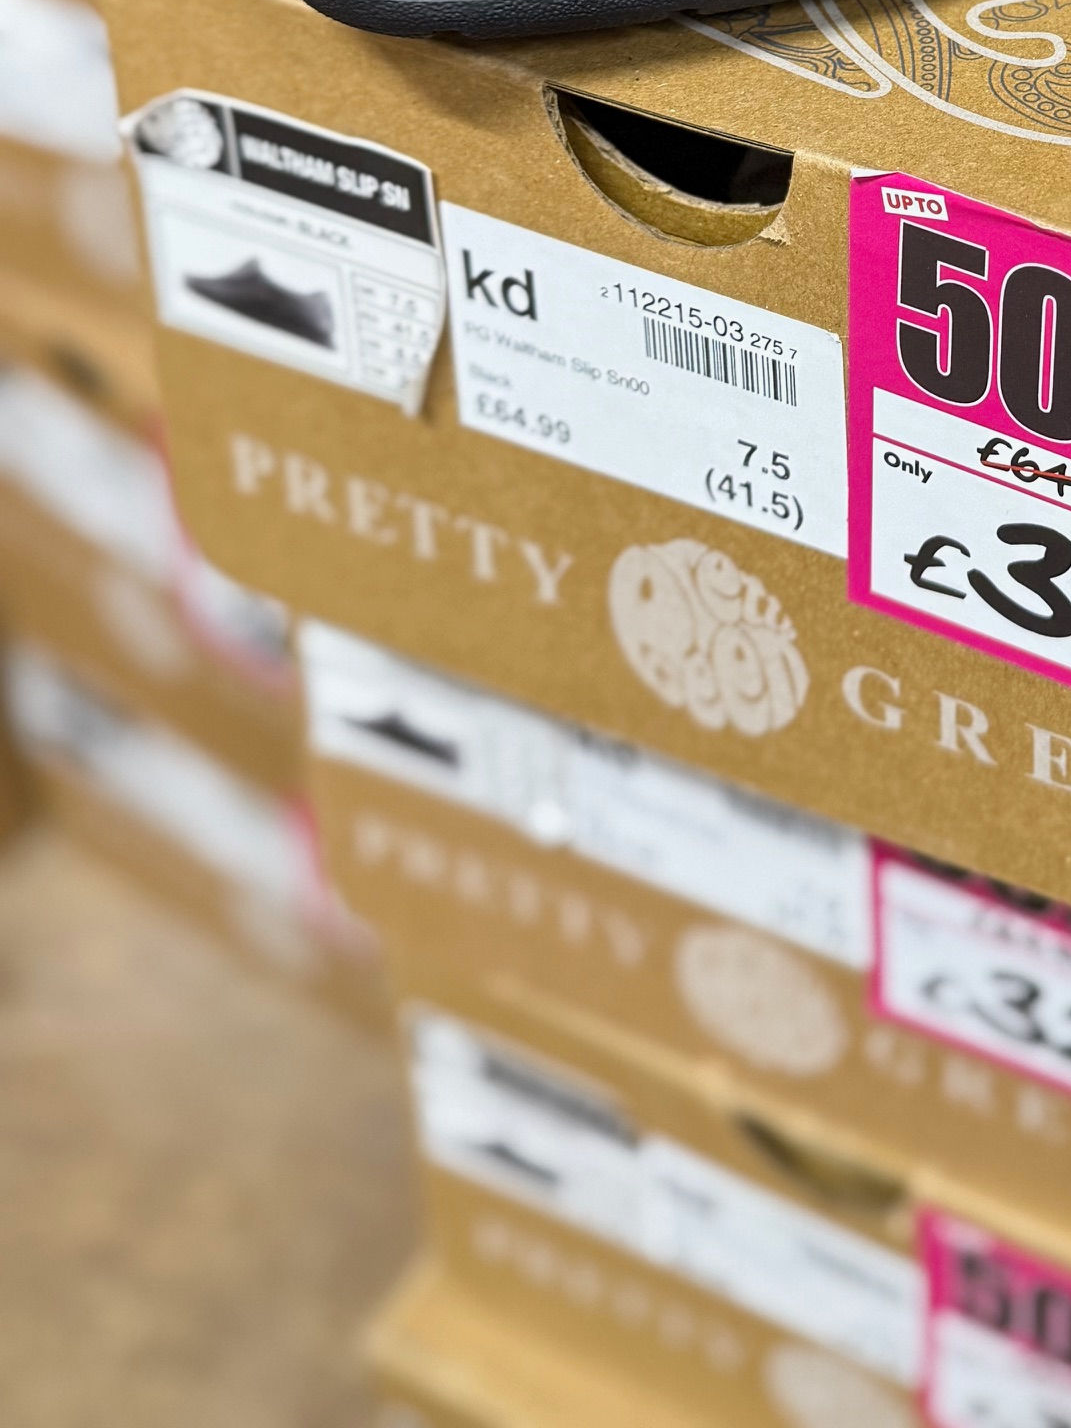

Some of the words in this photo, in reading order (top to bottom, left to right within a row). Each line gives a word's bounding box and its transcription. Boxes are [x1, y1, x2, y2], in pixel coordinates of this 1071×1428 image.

[240, 133, 335, 187] WALTHAM
[336, 166, 379, 199] SLIP
[380, 181, 411, 212] SN
[461, 249, 539, 322] kd
[613, 283, 744, 343] 112215-03
[750, 333, 784, 356] 275
[495, 331, 567, 368] Waltham
[570, 356, 602, 380] Slip
[606, 369, 651, 396] Sn00
[476, 392, 572, 445] £64.99
[737, 438, 792, 481] 7.5
[883, 451, 933, 483] Only
[225, 432, 577, 606] PRETTY
[705, 467, 804, 531] (41.5)
